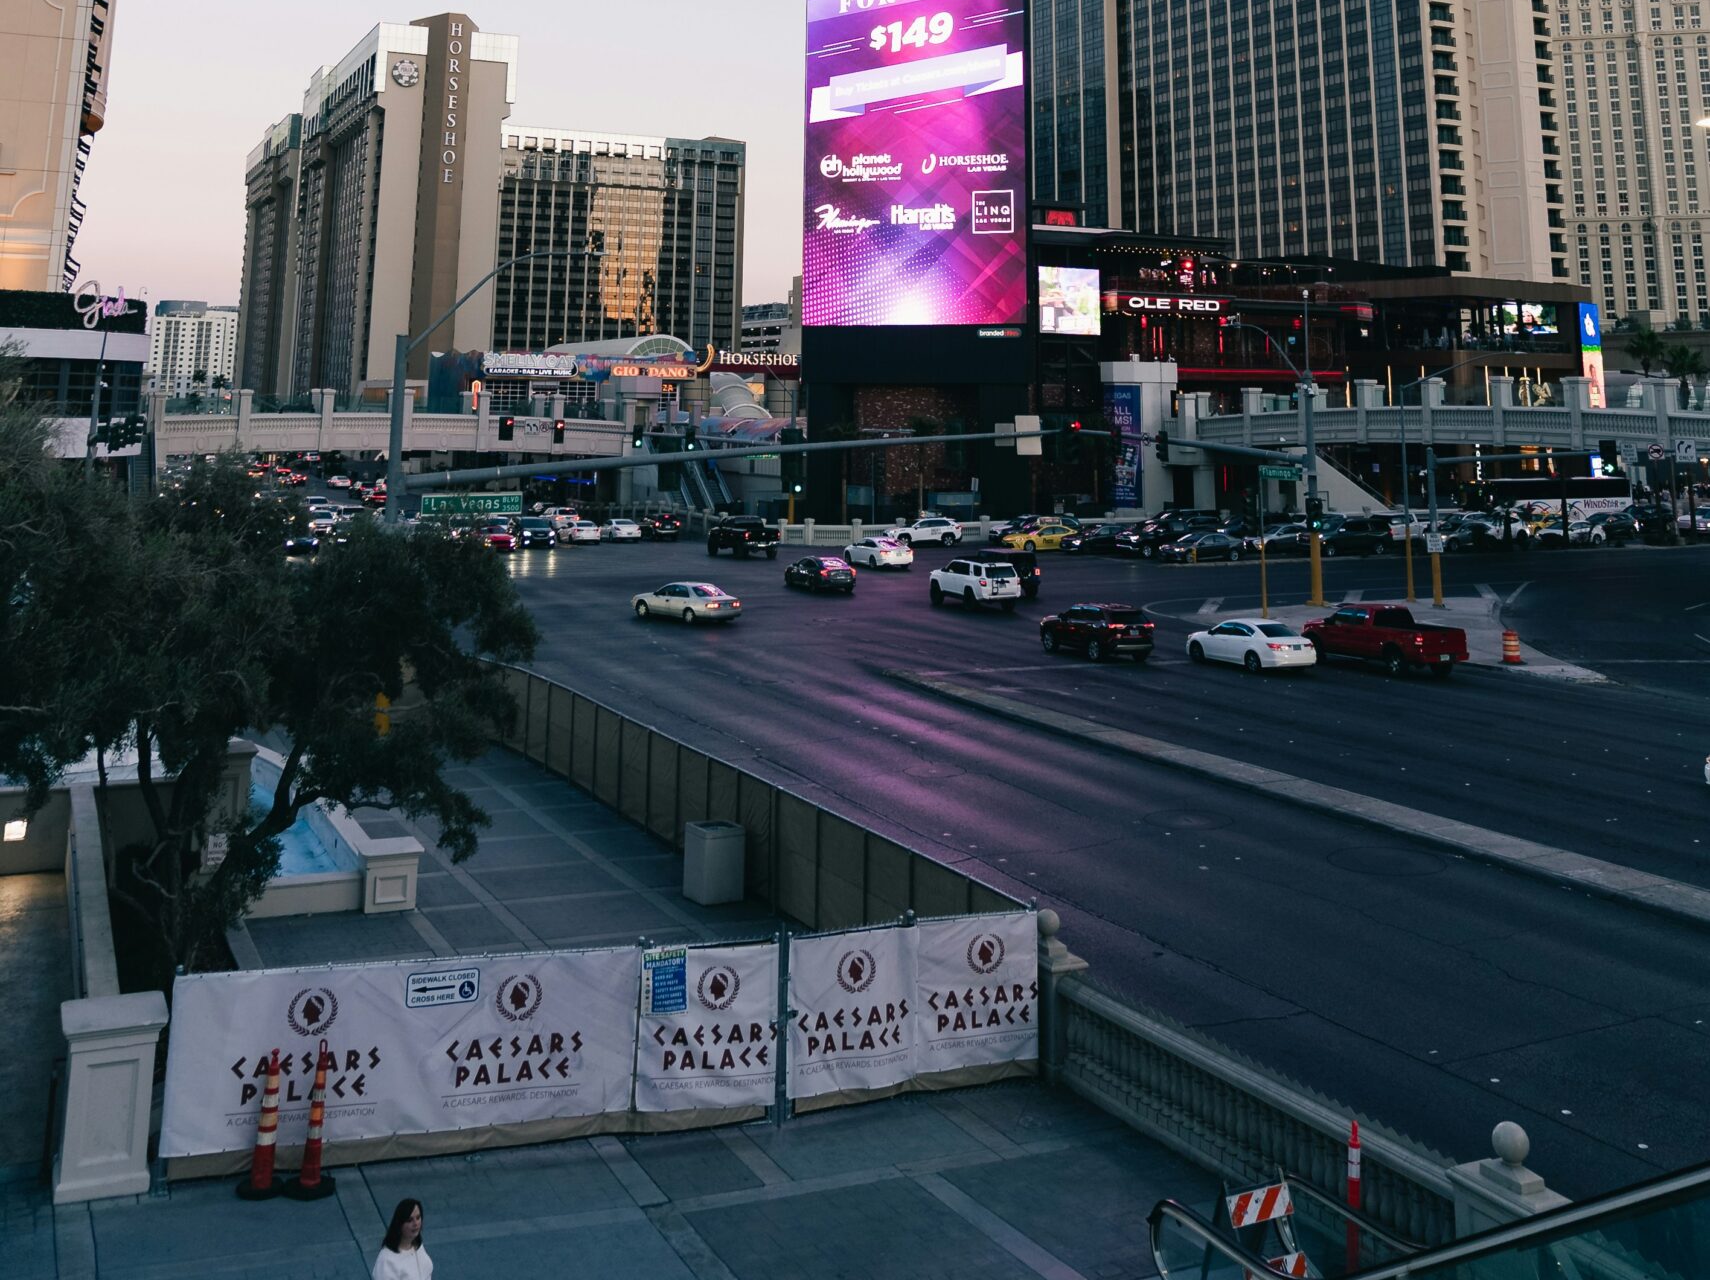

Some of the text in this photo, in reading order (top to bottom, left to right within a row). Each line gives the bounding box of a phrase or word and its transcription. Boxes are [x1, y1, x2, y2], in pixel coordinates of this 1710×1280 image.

[868, 11, 954, 53] $149
[442, 23, 463, 183] HORSESHOE
[852, 153, 891, 167] planet
[939, 154, 1008, 166] HORSESHOE
[843, 163, 902, 178] hollywood
[975, 205, 1011, 216] LINQ
[1129, 297, 1220, 312] OLE RED
[483, 352, 577, 369] SMELLY CAT
[719, 351, 798, 366] HORSESHOE
[1262, 467, 1291, 479] Flamingo
[461, 498, 500, 511] Vegas
[502, 496, 520, 504] BLVD
[646, 957, 685, 968] MANDATORY
[411, 972, 476, 985] SIDEWALK CLOSED
[411, 993, 455, 1004] CROSS HERE
[927, 981, 1038, 1011] CAESARS
[797, 998, 909, 1033] CAESARS
[937, 1004, 1030, 1033] PALACE
[653, 1022, 778, 1047] CAESARS
[807, 1024, 900, 1057] PALACE
[446, 1031, 583, 1063] CAESARS
[935, 1039, 965, 1051] CAESARS
[231, 1046, 381, 1080] CAESARS
[663, 1045, 768, 1072] PALACE
[455, 1057, 569, 1089] PALACE
[805, 1062, 835, 1074] CAESARS
[240, 1073, 365, 1106] PLCE
[660, 1080, 693, 1090] CAESARS
[442, 1101, 450, 1109] A
[450, 1094, 487, 1109] CAESARS
[529, 1088, 578, 1101] DESTINATION
